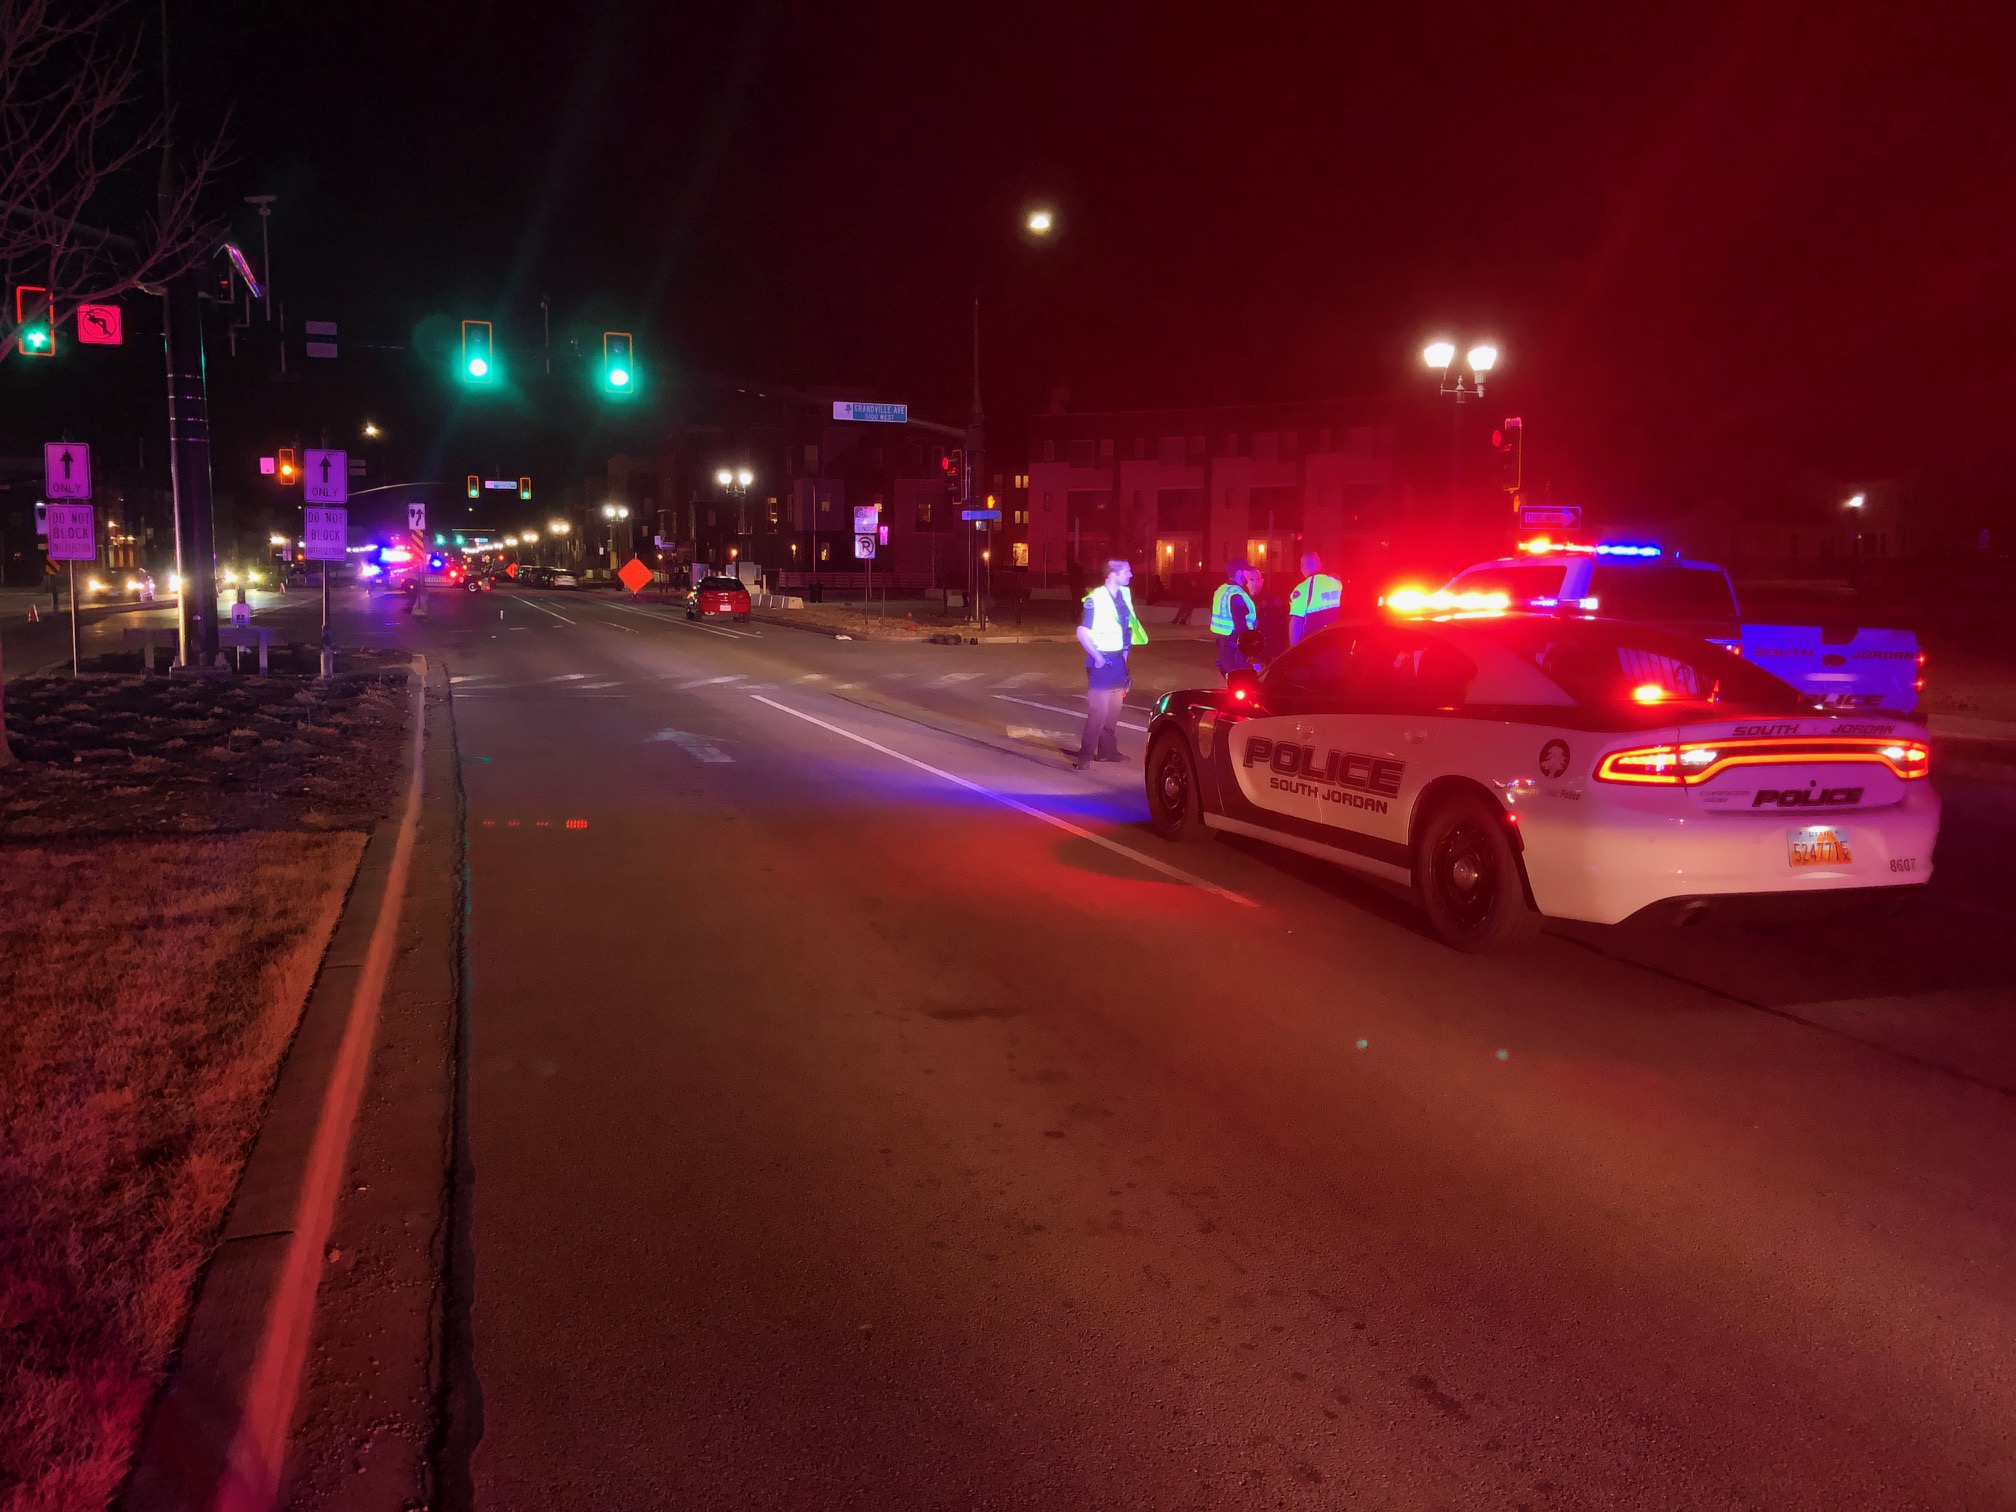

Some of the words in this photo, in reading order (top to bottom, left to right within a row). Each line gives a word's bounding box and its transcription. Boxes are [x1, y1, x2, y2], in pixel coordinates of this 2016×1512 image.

[854, 405, 892, 414] GRANDVILLE
[893, 406, 905, 415] AVE
[52, 483, 82, 494] ONLY
[311, 487, 339, 498] ONLY
[52, 512, 65, 524] DO
[71, 512, 90, 525] NOT
[308, 512, 320, 523] DO
[325, 512, 343, 524] NOT
[1526, 513, 1543, 522] ONE
[53, 528, 90, 540] BLOCK
[311, 529, 341, 541] BLOCK
[307, 546, 344, 555] INTERSECTION
[1754, 648, 1813, 658] SOUTH
[1851, 651, 1915, 660] JORDAN
[1732, 724, 1800, 737] SOUTH
[1830, 724, 1896, 735] JORDAN
[1243, 735, 1406, 800] POLICE
[1269, 777, 1319, 798] SOUTH
[1321, 789, 1388, 815] JORDAN
[1751, 787, 1865, 807] POLICE
[1889, 857, 1916, 872] 8607
